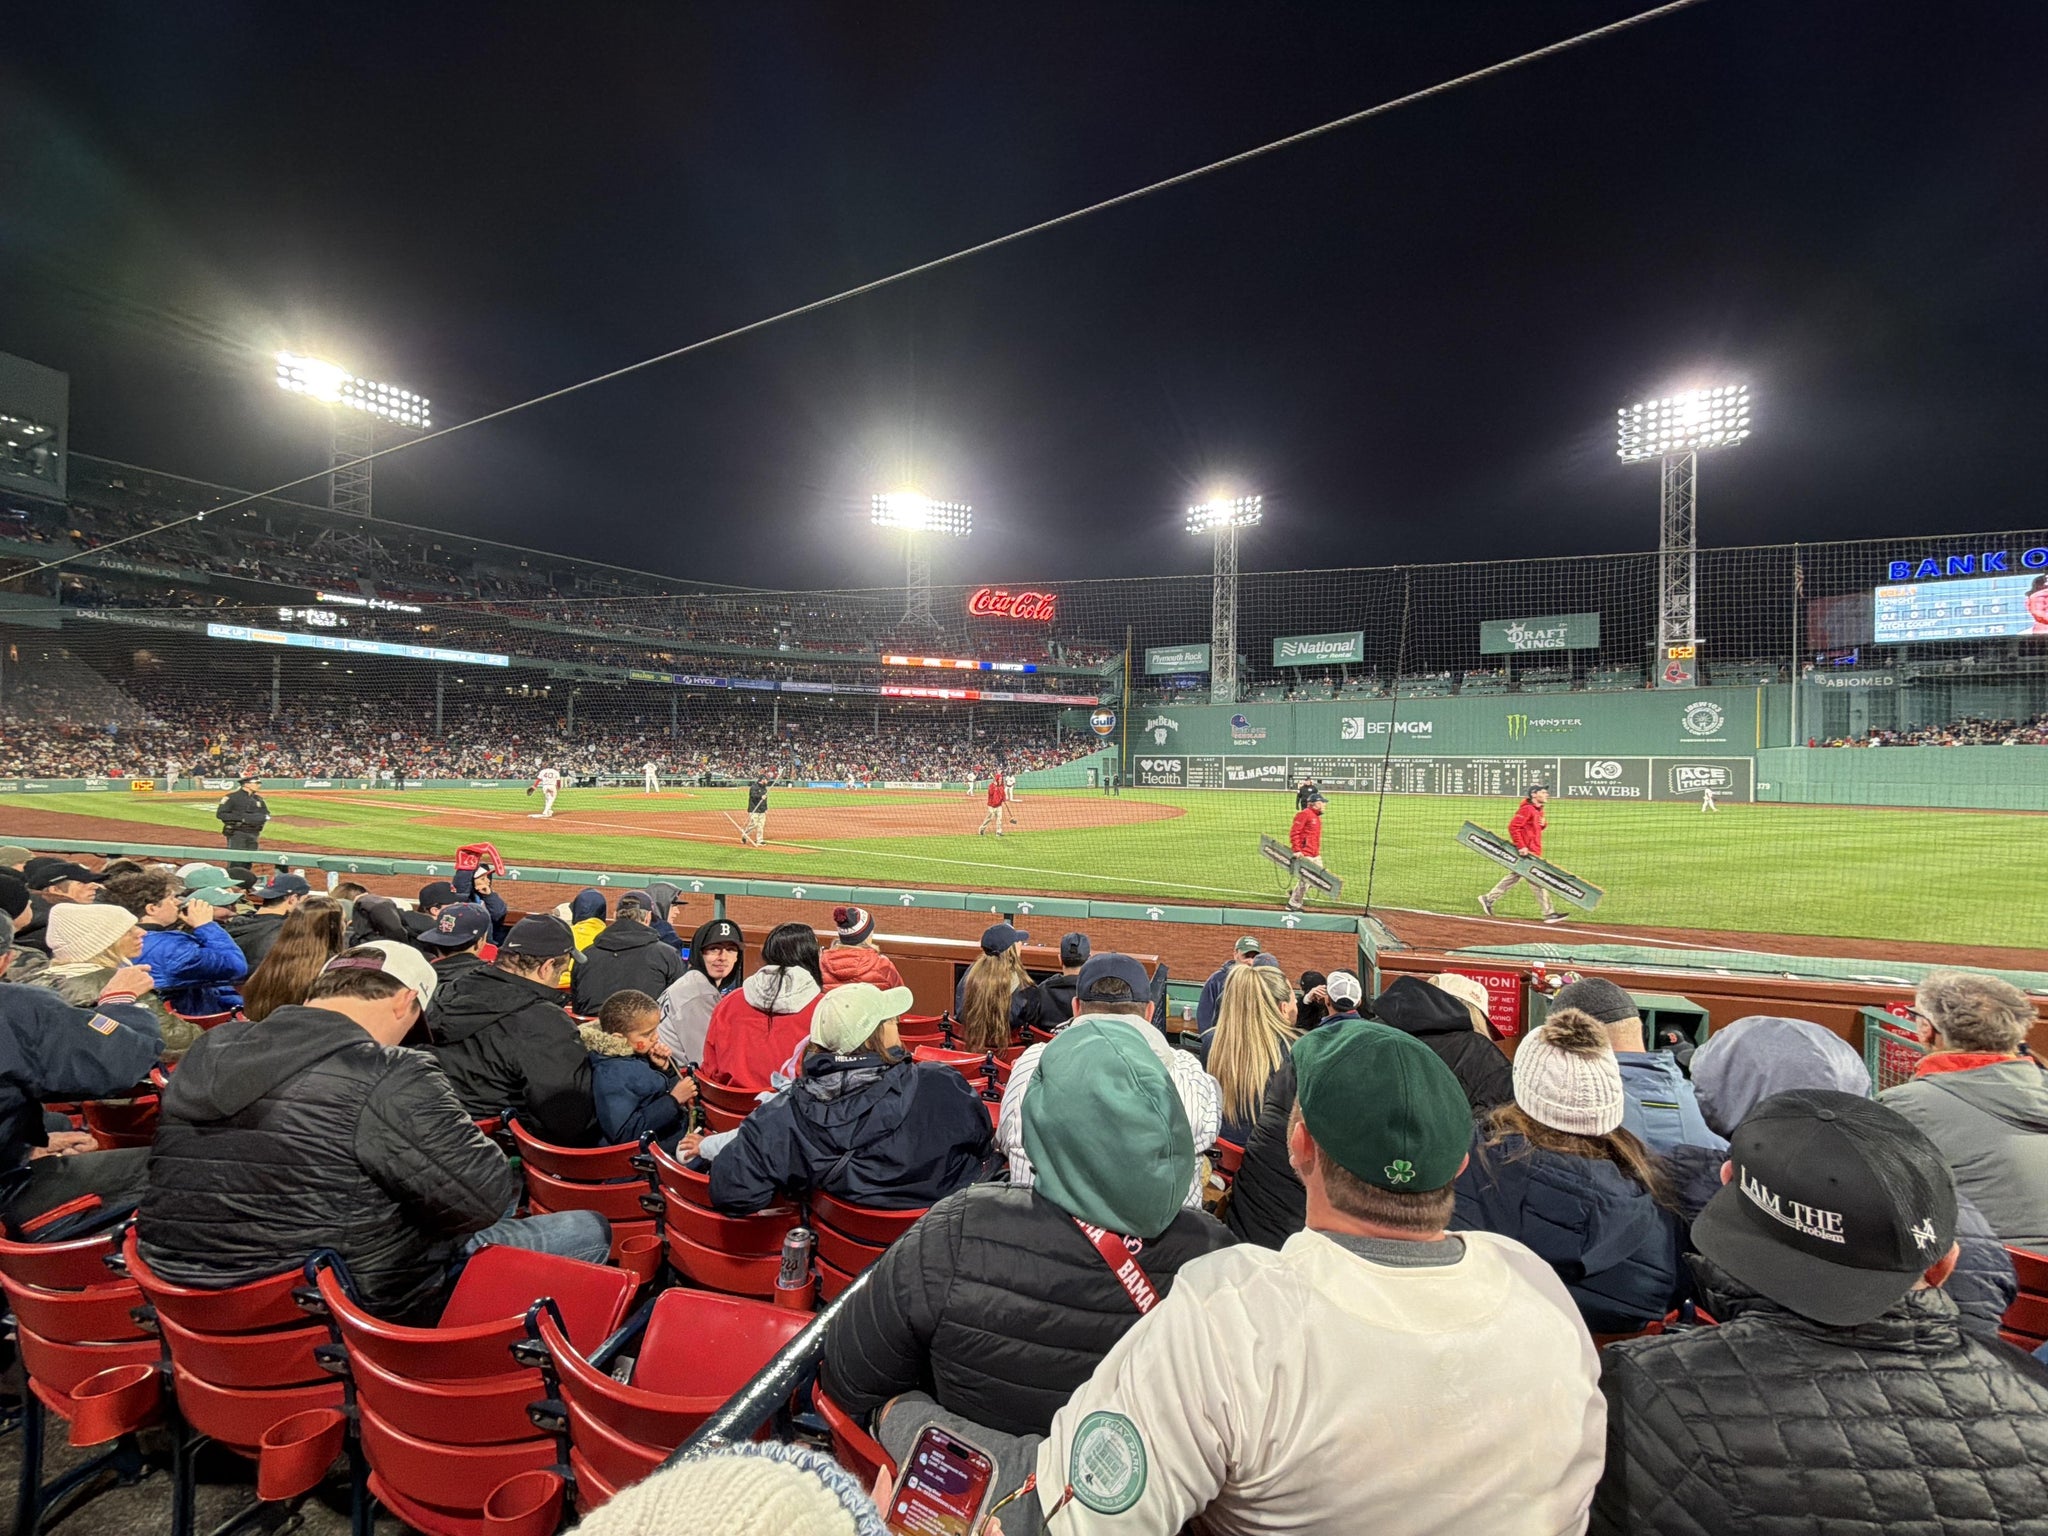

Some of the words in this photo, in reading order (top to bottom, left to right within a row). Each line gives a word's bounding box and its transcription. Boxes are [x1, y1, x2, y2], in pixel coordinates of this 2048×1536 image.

[99, 560, 133, 571] AURA
[1888, 551, 2008, 580] BANK
[969, 588, 1058, 621] Coca-Cola
[76, 610, 108, 620] DELL
[1507, 629, 1568, 643] DRAFT
[1297, 639, 1355, 655] National
[1514, 638, 1566, 650] KINGS
[1152, 653, 1183, 664] Plymouth
[1184, 652, 1203, 660] Rock
[1329, 651, 1352, 659] Rental
[1668, 648, 1696, 659] 0:52
[693, 677, 716, 685] HYCU
[1826, 677, 1894, 688] ABIOMED
[1091, 716, 1115, 727] Gulf
[1145, 719, 1159, 732] JIM
[1158, 715, 1179, 732] BEAM
[1367, 721, 1432, 733] BETMGM
[1529, 717, 1582, 727] MONSTER
[1153, 759, 1182, 772] CVS
[1141, 773, 1182, 785] Health
[1681, 767, 1726, 780] ACE
[1681, 779, 1726, 788] TICKET
[1568, 786, 1593, 796] F.W.
[1596, 786, 1641, 797] WEBB
[1469, 834, 1517, 863] PENNINGTON
[1531, 867, 1584, 898] PENNINGTON
[719, 923, 731, 936] B
[1749, 1176, 1783, 1214] AM
[1788, 1200, 1844, 1235] THE
[1795, 1220, 1846, 1244] Problem
[1116, 1258, 1156, 1314] BAMA
[1127, 1441, 1140, 1474] PARK
